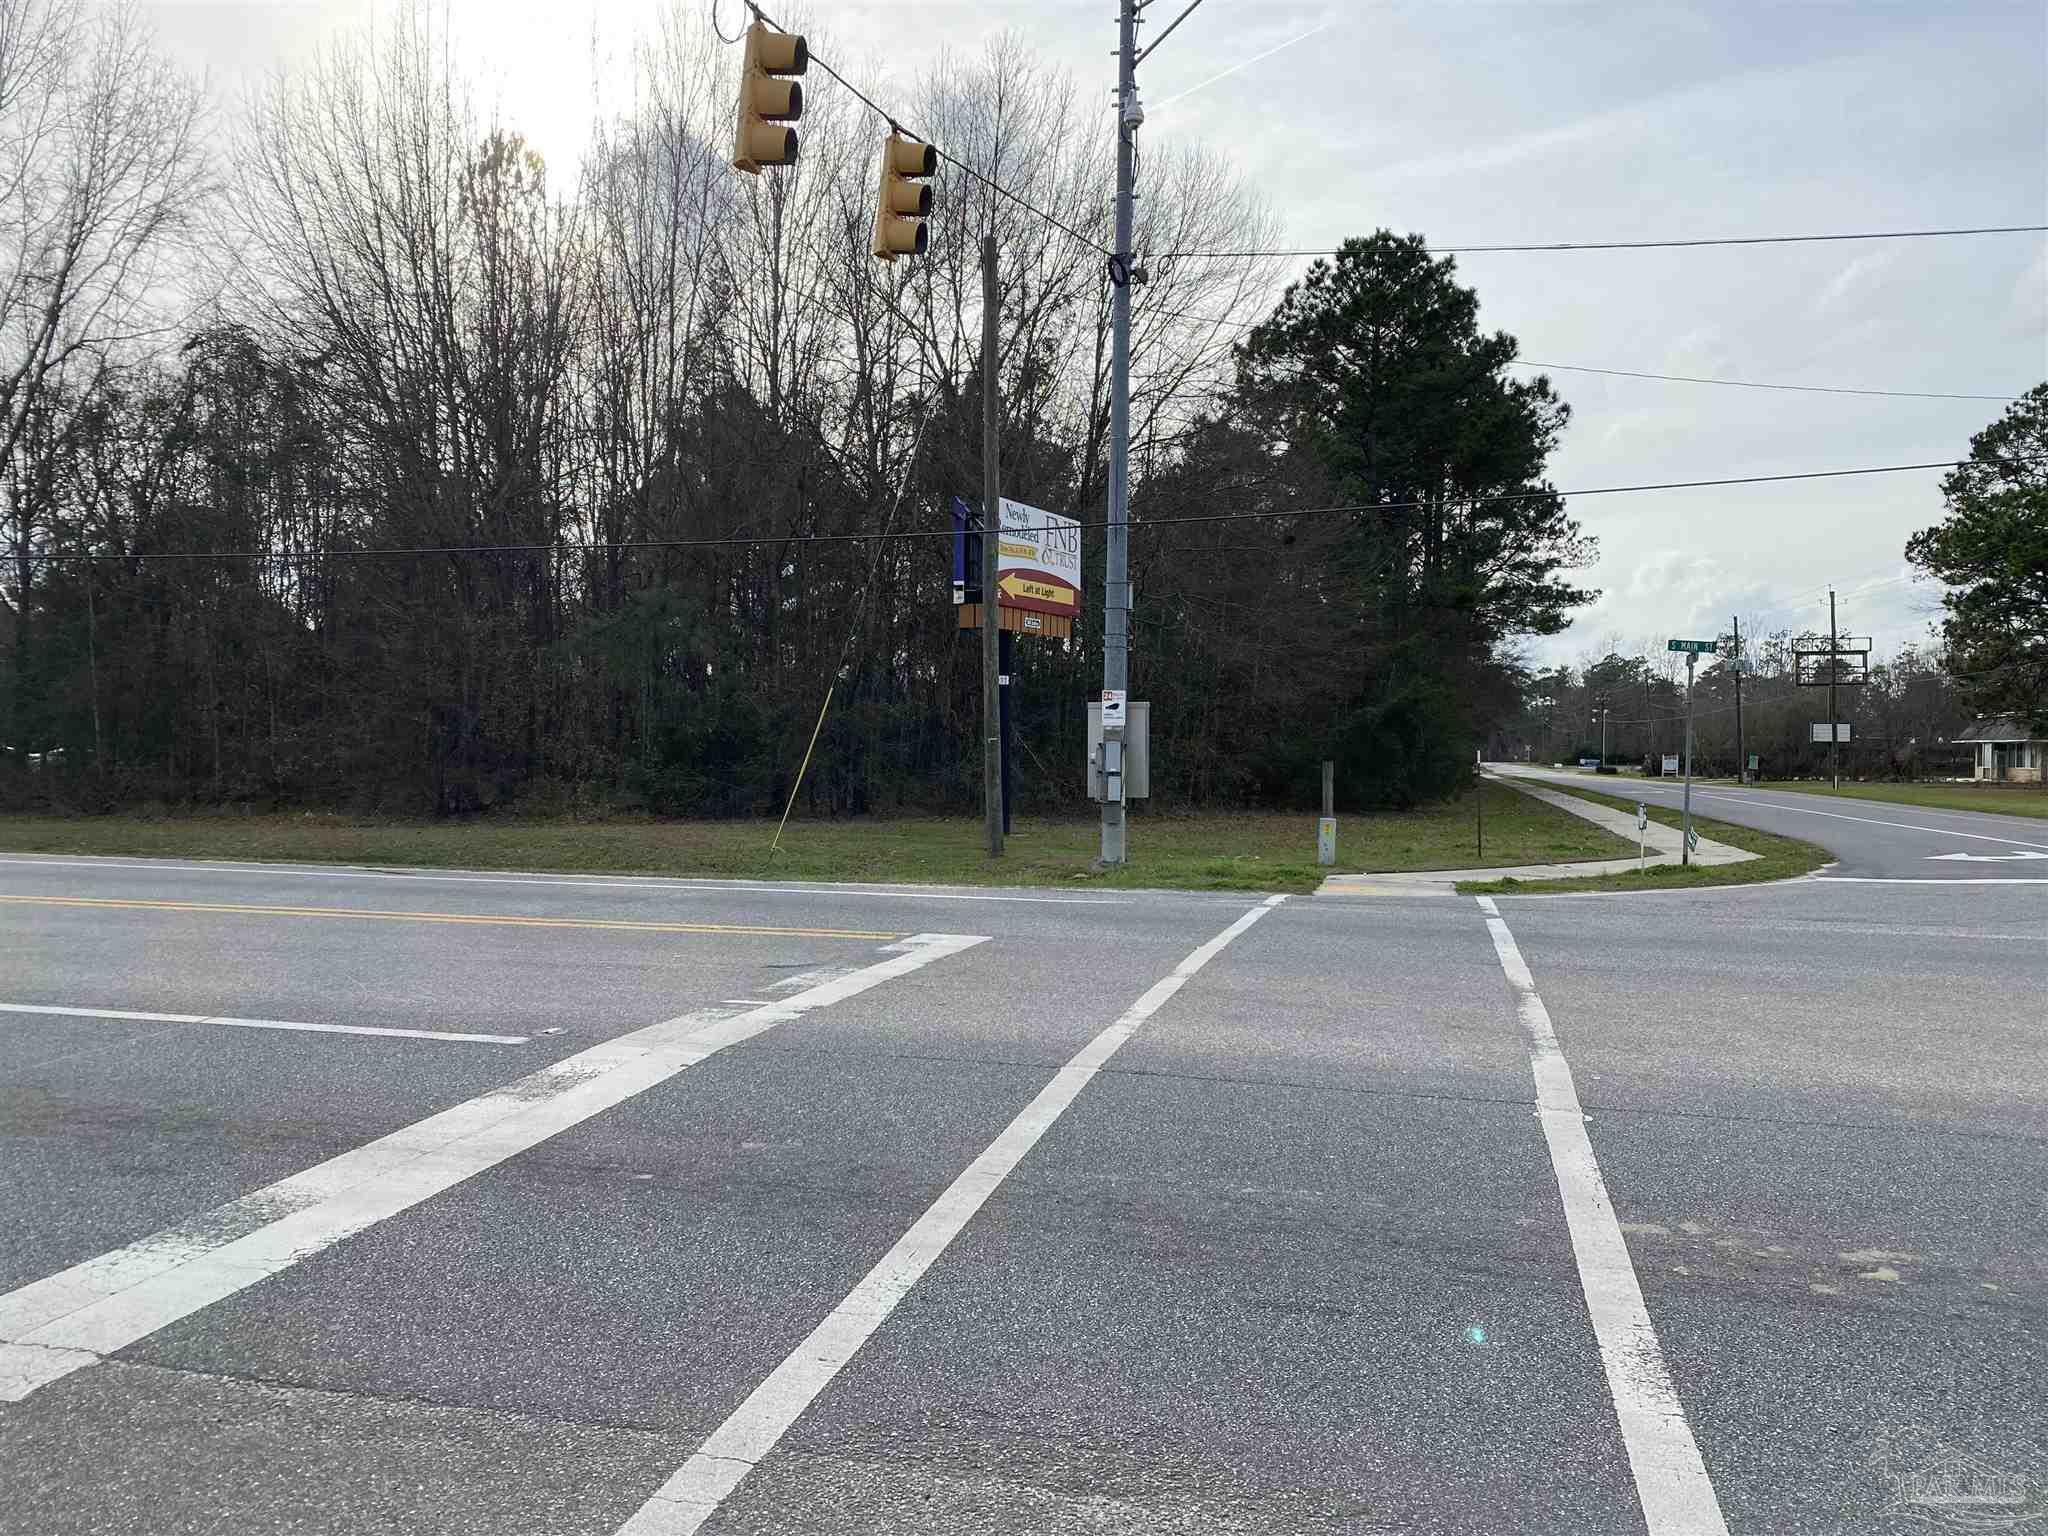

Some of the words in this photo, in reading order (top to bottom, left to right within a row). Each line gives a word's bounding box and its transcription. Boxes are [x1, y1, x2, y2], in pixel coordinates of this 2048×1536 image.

[1006, 503, 1030, 523] Newly
[1000, 519, 1039, 543] emodeled
[1045, 515, 1078, 552] FNB
[1023, 583, 1034, 594] Left
[1041, 586, 1055, 598] Light
[1671, 641, 1676, 649] S
[1680, 642, 1698, 650] MAIN
